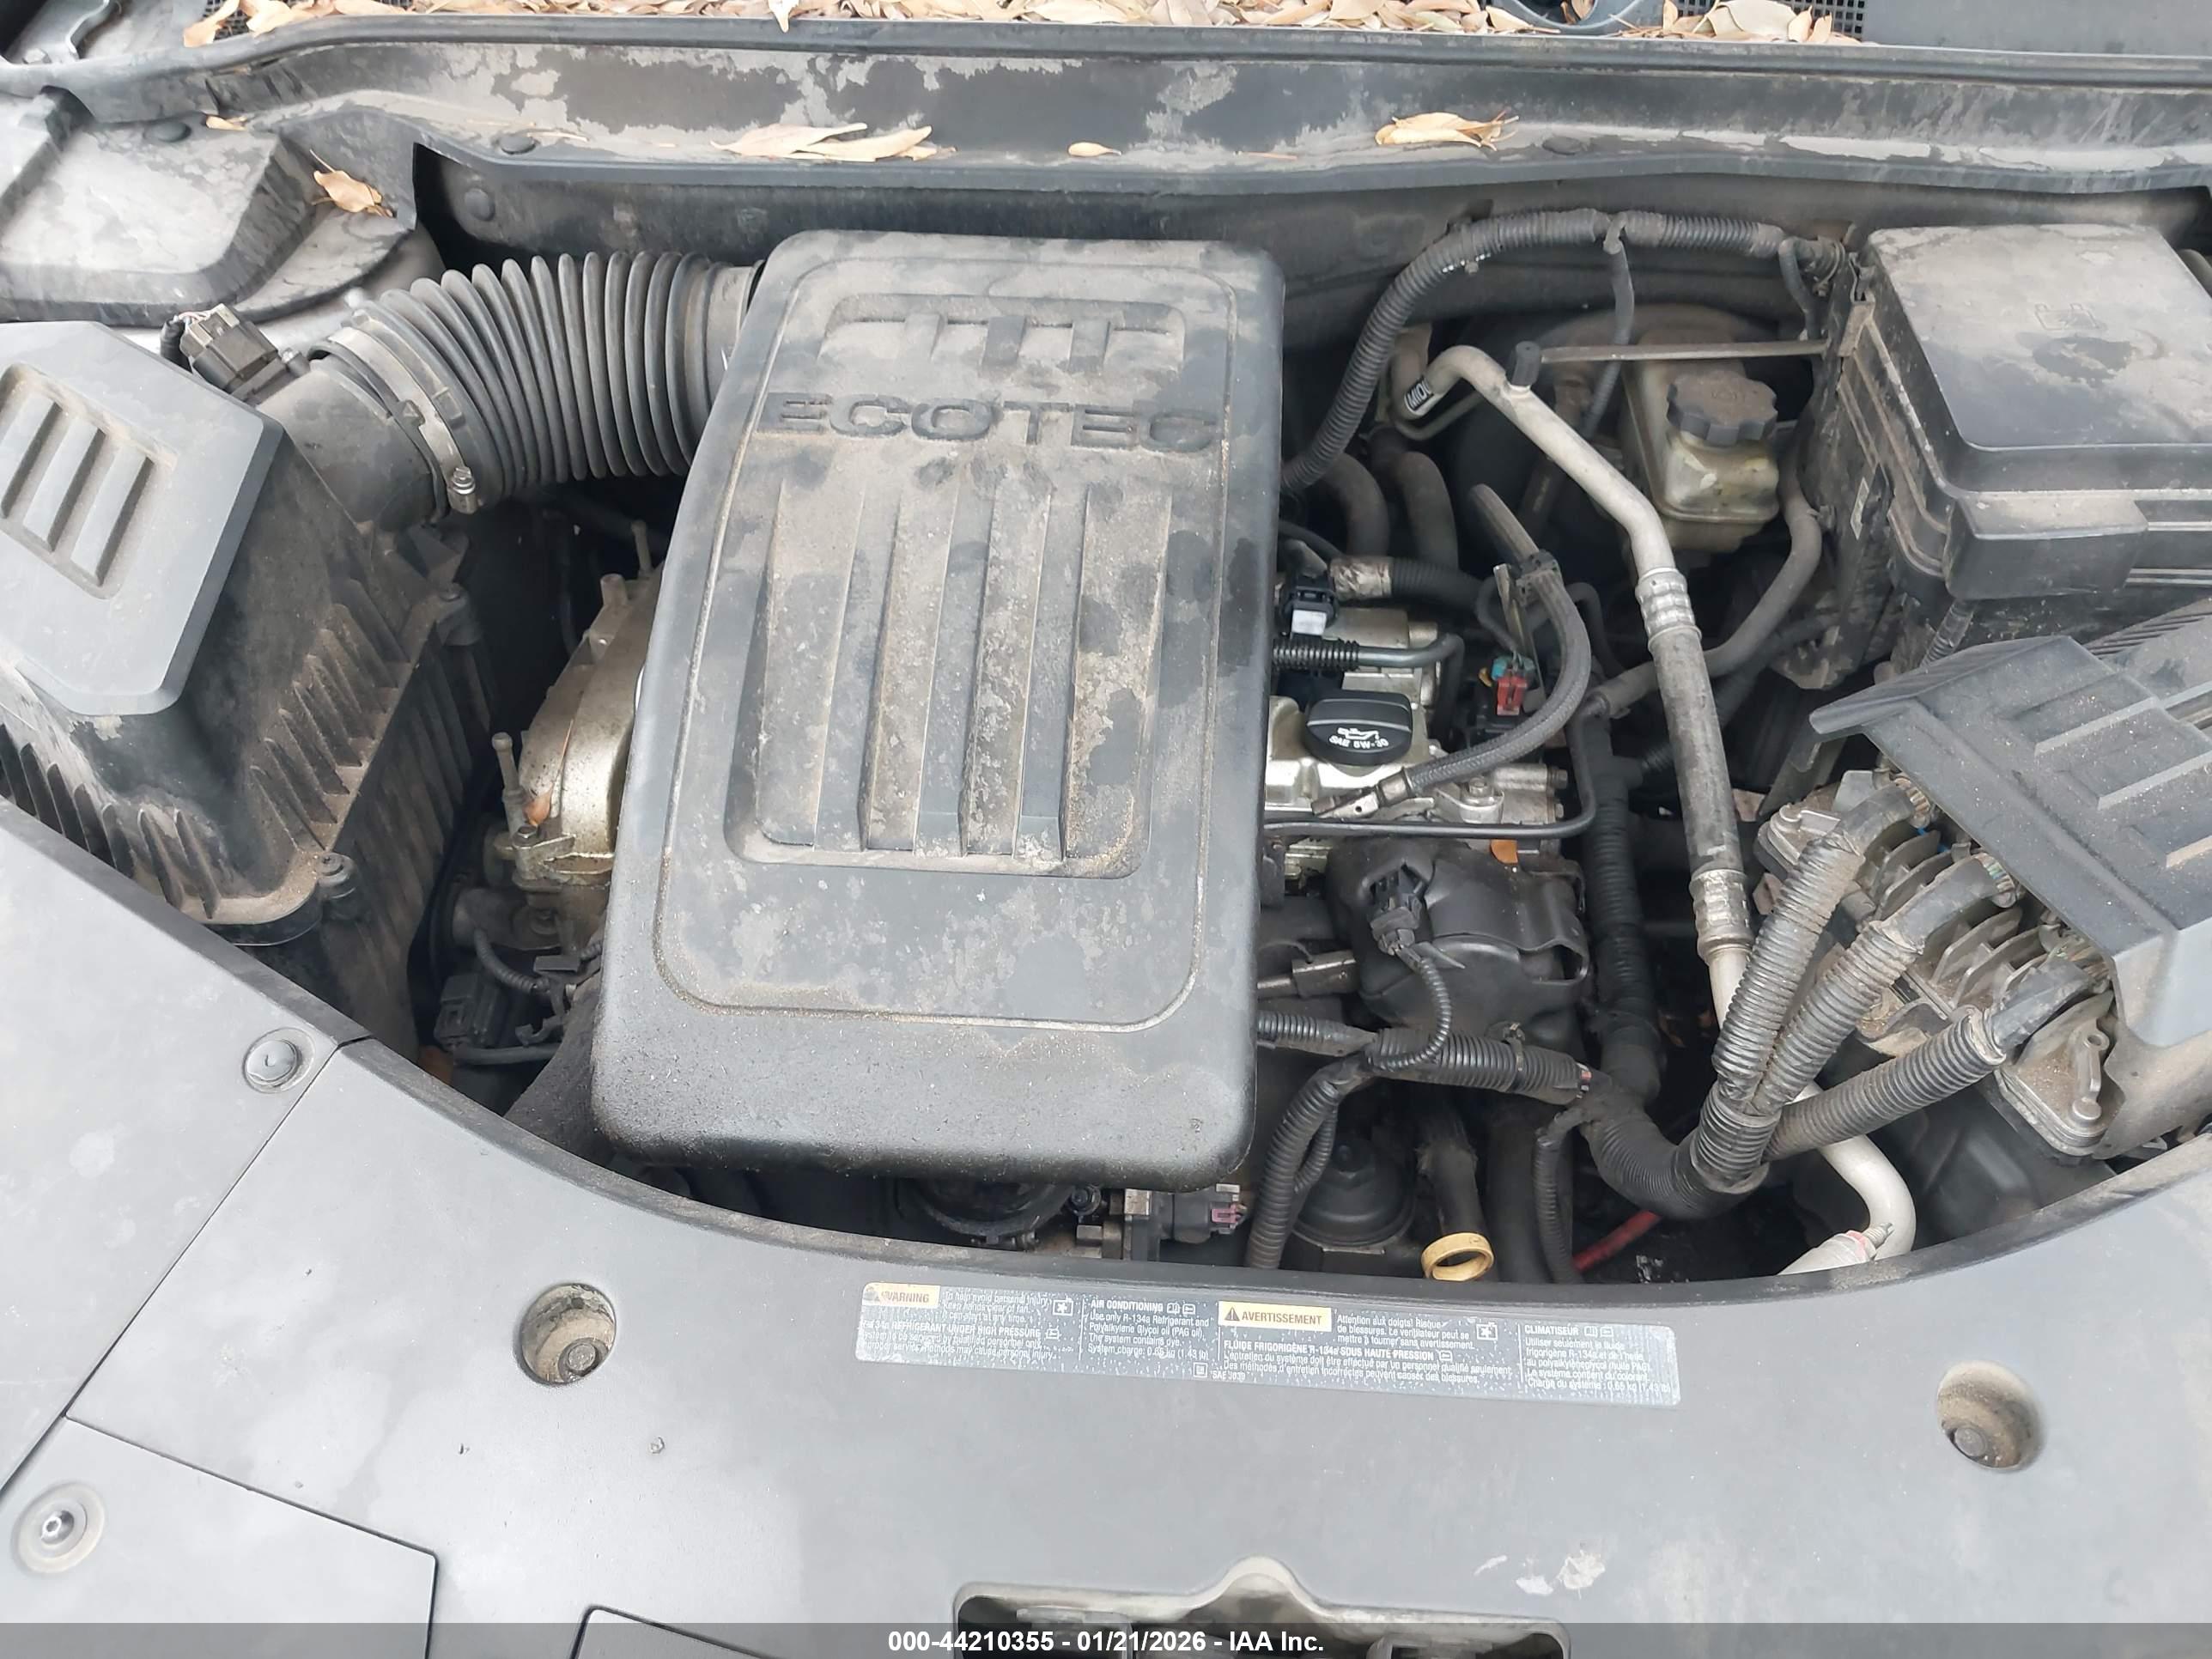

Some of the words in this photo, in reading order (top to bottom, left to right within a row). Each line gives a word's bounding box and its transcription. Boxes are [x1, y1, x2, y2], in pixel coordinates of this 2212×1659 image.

[756, 392, 1218, 453] ECOTEC
[1328, 735, 1351, 747] SAE
[1353, 738, 1389, 749] 5W-30
[1091, 1299, 1104, 1309] AIR
[1107, 1300, 1164, 1312] CONDITIONING
[1090, 1310, 1104, 1320] Use
[1106, 1312, 1121, 1322] only
[1122, 1314, 1151, 1323] R-134a
[1152, 1315, 1194, 1327] Refrigerant
[1195, 1317, 1209, 1327] and
[1242, 1311, 1322, 1325] AVERTISSEMENT
[1337, 1314, 1370, 1326] Attention
[1372, 1316, 1386, 1326] aux
[948, 1324, 975, 1334] UNDER
[978, 1325, 996, 1335] HIGH
[999, 1326, 1042, 1338] PRESSURE
[1090, 1322, 1134, 1334] Polyalkylene
[1138, 1325, 1158, 1336] Glycol
[1161, 1326, 1170, 1335] oil
[1172, 1327, 1189, 1337] (PAG
[1337, 1324, 1346, 1333] de
[1349, 1325, 1386, 1336] blessures.
[1389, 1327, 1398, 1336] Le
[1442, 1330, 1459, 1340] peut
[1525, 1324, 1579, 1335] CLIMATISEUR
[1089, 1333, 1103, 1342] The
[1104, 1334, 1131, 1344] system
[1133, 1335, 1164, 1345] contains
[1166, 1338, 1182, 1347] dye.
[1338, 1334, 1362, 1344] mettre
[1401, 1339, 1418, 1347] sans
[1088, 1343, 1115, 1354] System
[1224, 1340, 1252, 1350] FLUIDE
[1255, 1340, 1307, 1352] FRIGORIGÈNE
[1340, 1346, 1363, 1357] SOUS
[1392, 1349, 1434, 1360] PRESSION
[1224, 1359, 1237, 1370] Des
[1265, 1352, 1275, 1362] du
[1376, 1359, 1388, 1370] par
[1527, 1358, 1536, 1367] au
[1212, 1370, 1226, 1380] SAE
[1528, 1368, 1537, 1376] Le
